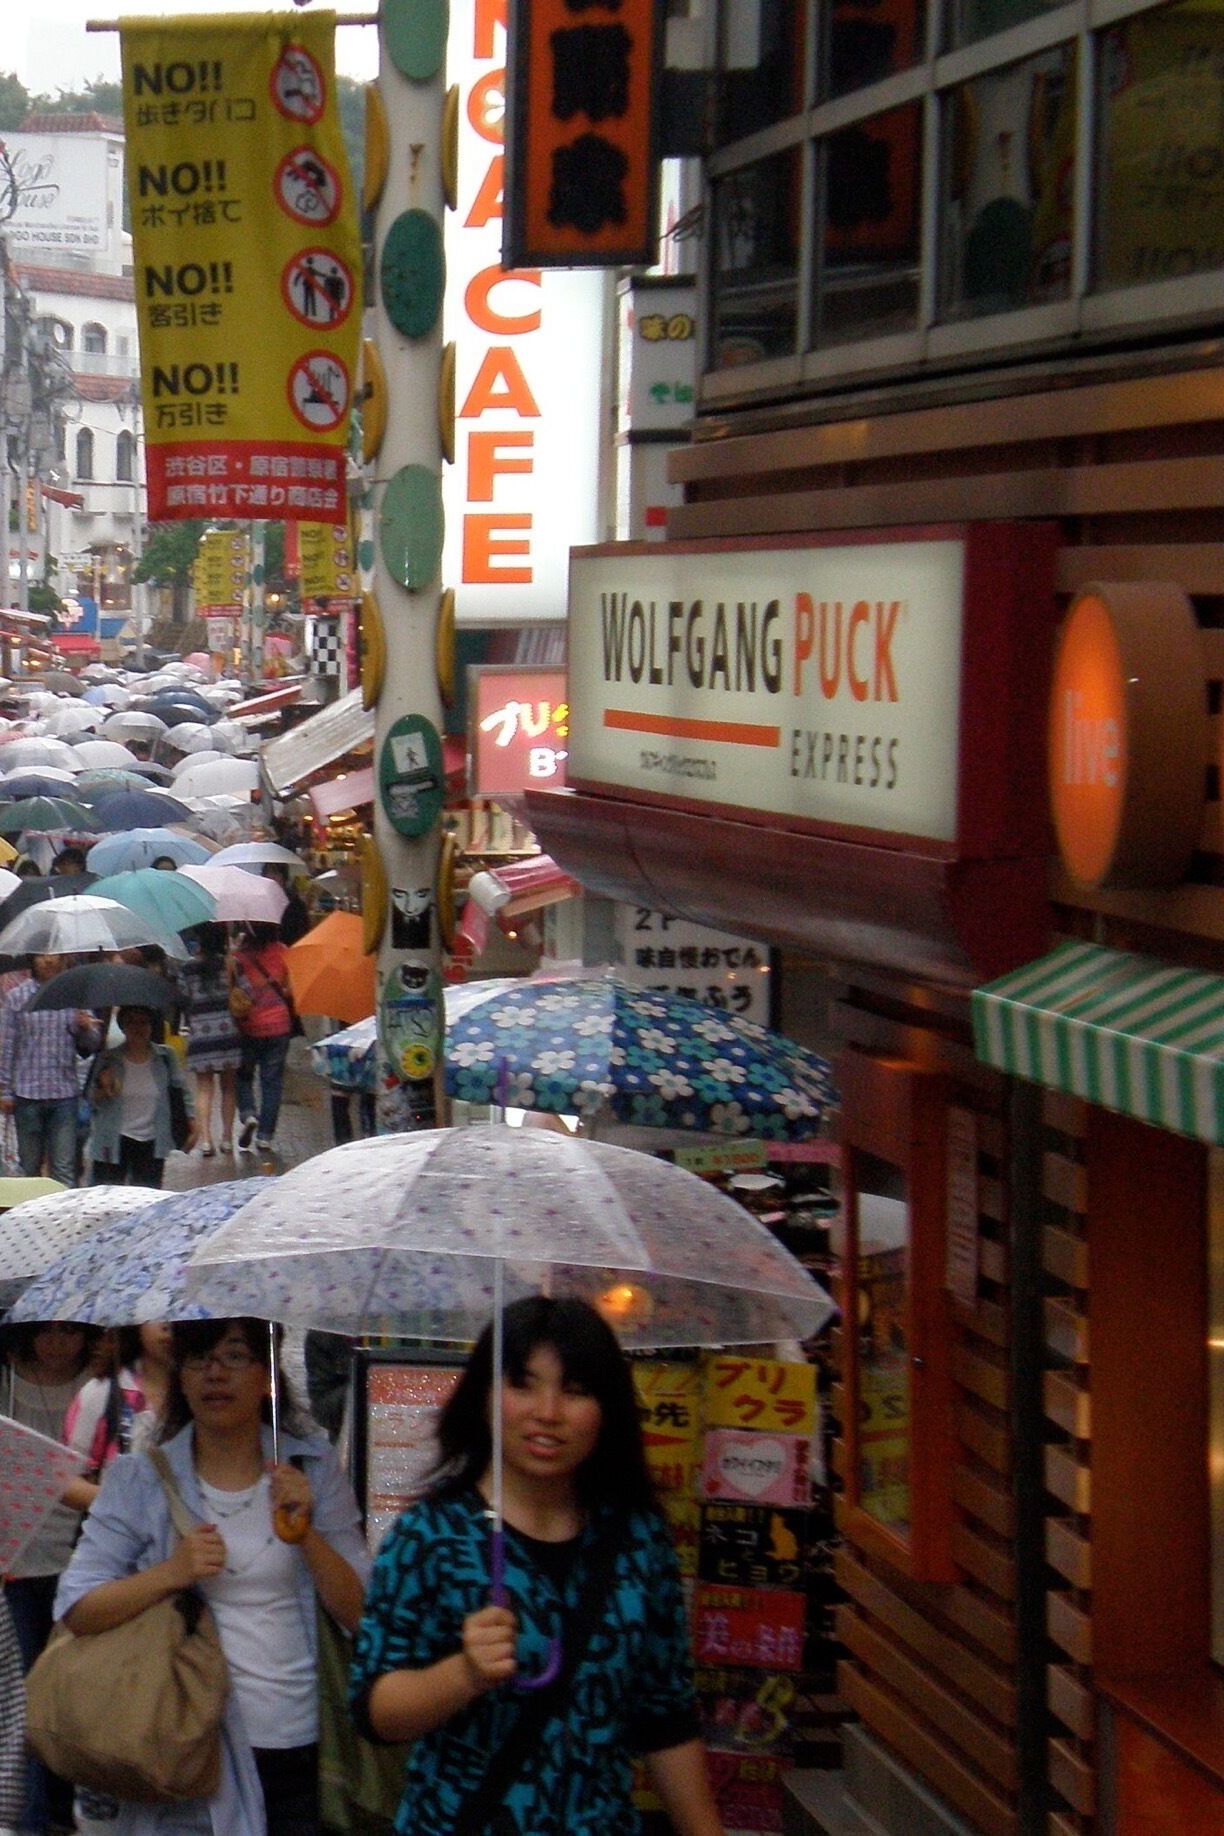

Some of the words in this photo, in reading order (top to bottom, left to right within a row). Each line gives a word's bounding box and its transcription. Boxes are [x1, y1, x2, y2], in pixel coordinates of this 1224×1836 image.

[133, 61, 222, 96] NO!!
[138, 160, 226, 197] NO!!
[145, 262, 233, 297] NO!!
[152, 362, 239, 397] NO!!
[157, 402, 227, 428] 万引き
[459, 262, 542, 584] CAFE
[601, 592, 783, 694] WOLFGANG
[793, 592, 902, 703] PUCK
[791, 729, 901, 789] EXPRESS
